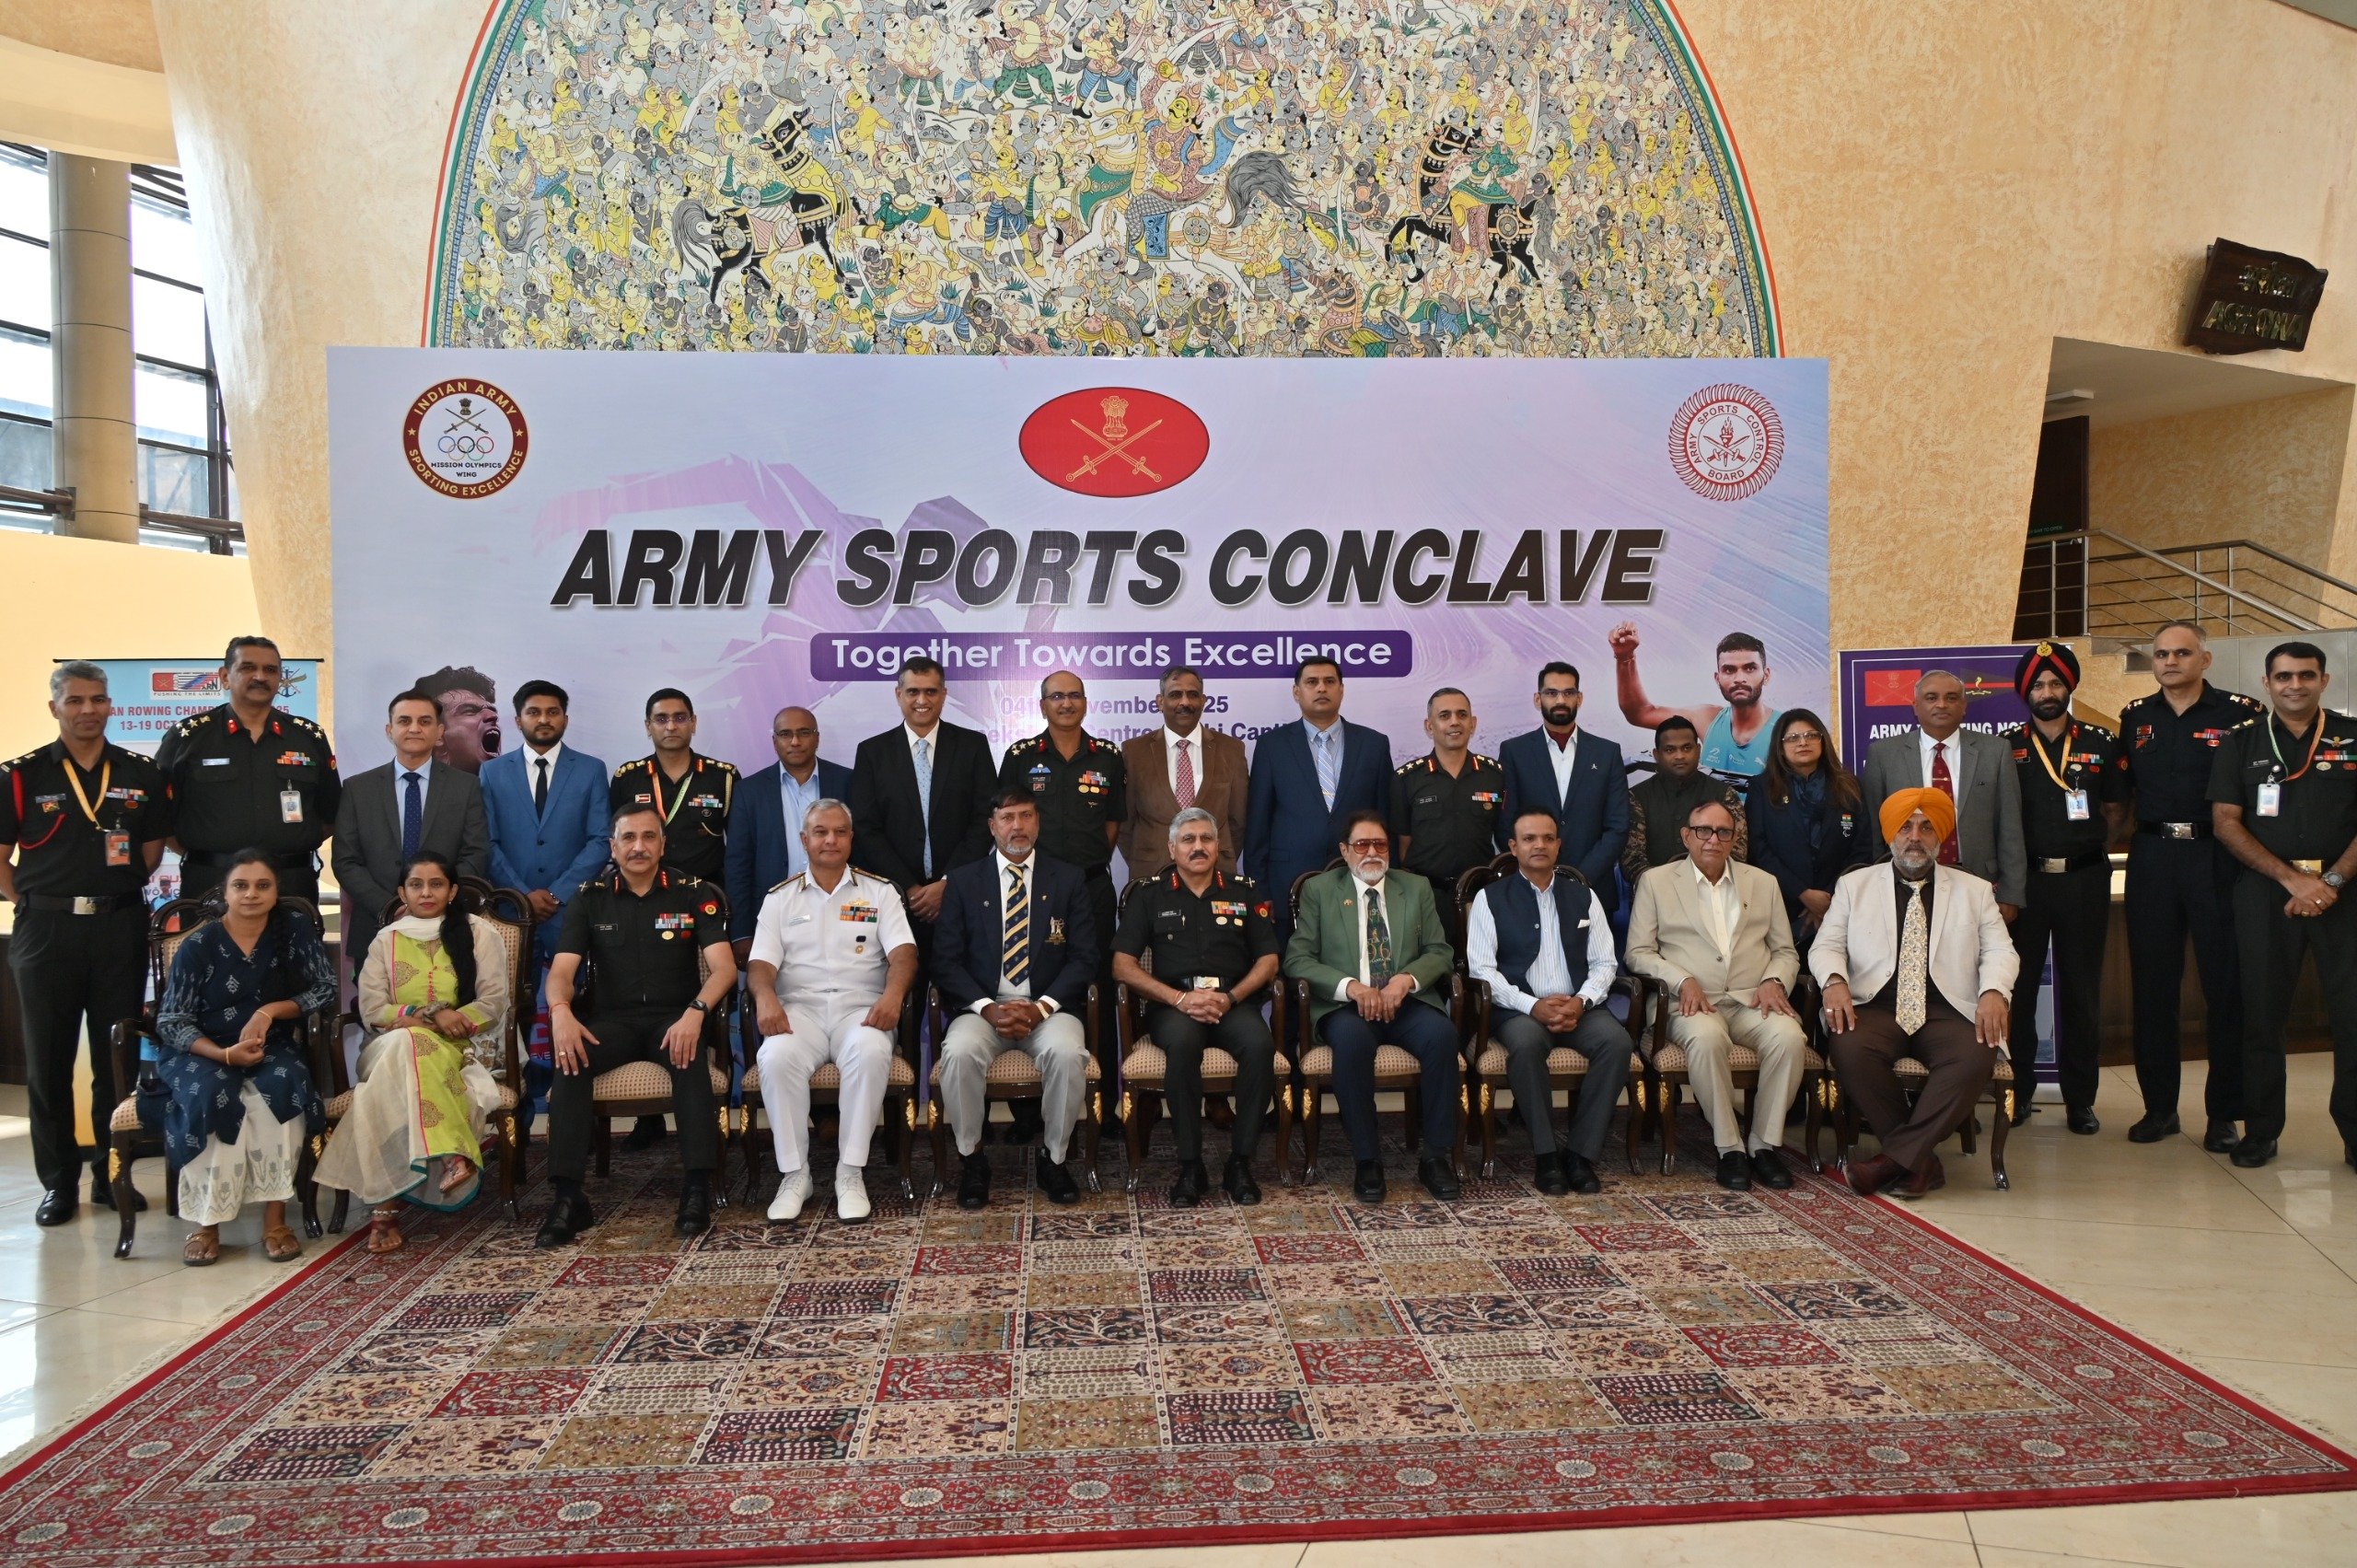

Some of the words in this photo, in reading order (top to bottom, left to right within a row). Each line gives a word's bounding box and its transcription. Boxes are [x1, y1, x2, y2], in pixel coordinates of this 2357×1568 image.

[413, 381, 468, 416] INDIAN
[475, 384, 517, 416] ARMY
[1698, 405, 1738, 424] SPORTS
[1689, 433, 1702, 464] ARMY
[1747, 414, 1764, 463] CONTROL
[409, 449, 459, 494] SPORTING
[462, 449, 523, 495] EXCELLENCE
[1708, 470, 1745, 481] BOARD
[550, 528, 825, 606] ARMY
[835, 528, 1187, 607] SPORTS
[1208, 528, 1665, 606] CONCLAVE
[831, 639, 1004, 676] Together
[1014, 637, 1170, 668] Towards
[1185, 636, 1392, 667] Excellence
[129, 706, 172, 715] ROWING
[1087, 695, 1160, 714] vembe
[1203, 695, 1229, 713] 25
[121, 720, 152, 730] 13-19
[1869, 724, 1912, 739] ARMY
